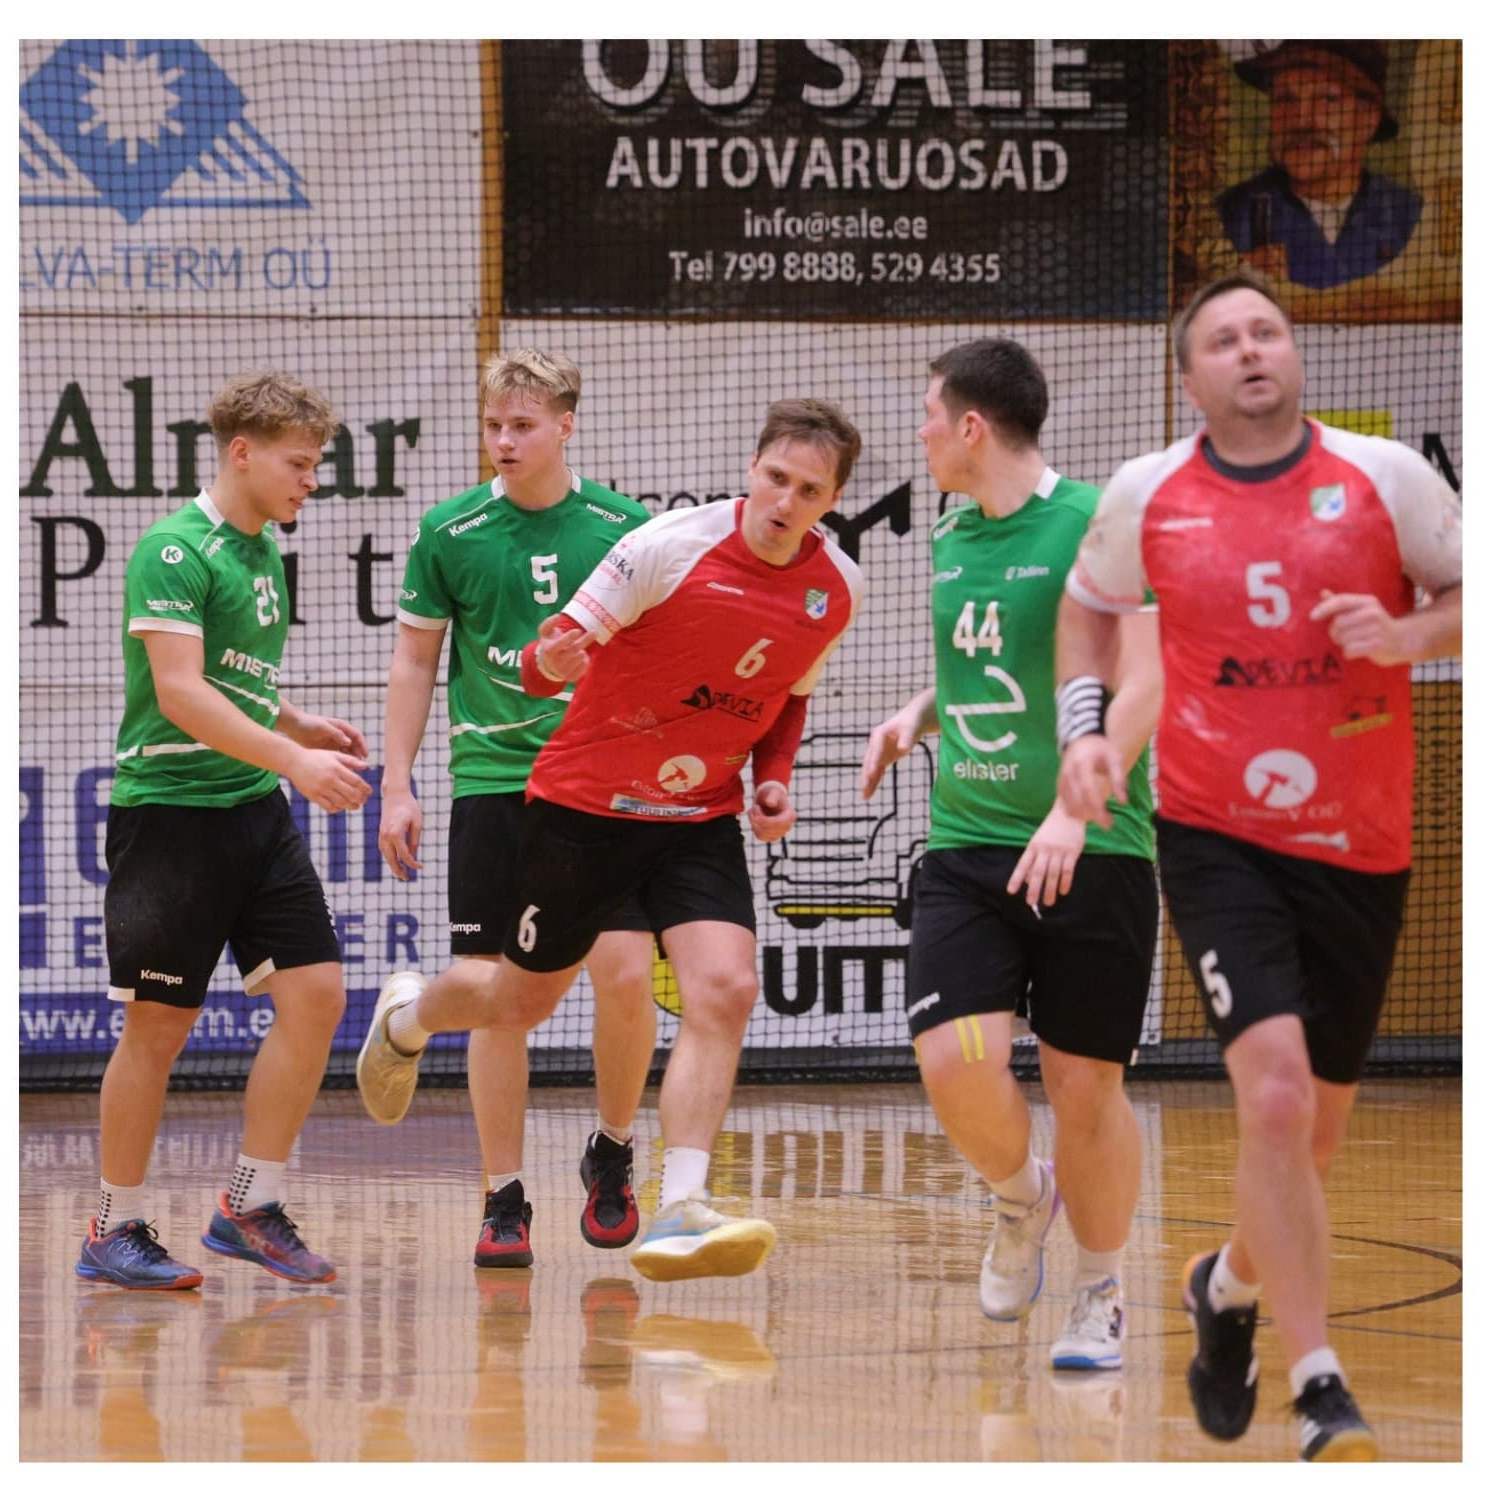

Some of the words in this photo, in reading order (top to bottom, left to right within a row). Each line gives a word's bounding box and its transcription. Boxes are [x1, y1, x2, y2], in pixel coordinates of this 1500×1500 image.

[802, 39, 1093, 109] SALE
[605, 136, 1068, 193] AUTOVARUOSAD
[743, 208, 928, 241] info@sale.ee
[19, 246, 242, 291] VA-TERM
[263, 240, 331, 291] OÜ
[670, 251, 714, 283] Tel
[723, 251, 778, 284] 799
[784, 250, 864, 288] 8888,
[871, 251, 923, 284] 529
[930, 251, 1001, 284] 4355
[449, 513, 488, 537] Kempa
[253, 576, 281, 627] 21
[531, 554, 559, 605] 5
[1246, 561, 1291, 629] 5
[952, 601, 1003, 657] 44
[735, 638, 775, 679] 6
[517, 904, 541, 953] 6
[141, 969, 184, 986] Kempa
[1200, 949, 1233, 1018] 5
